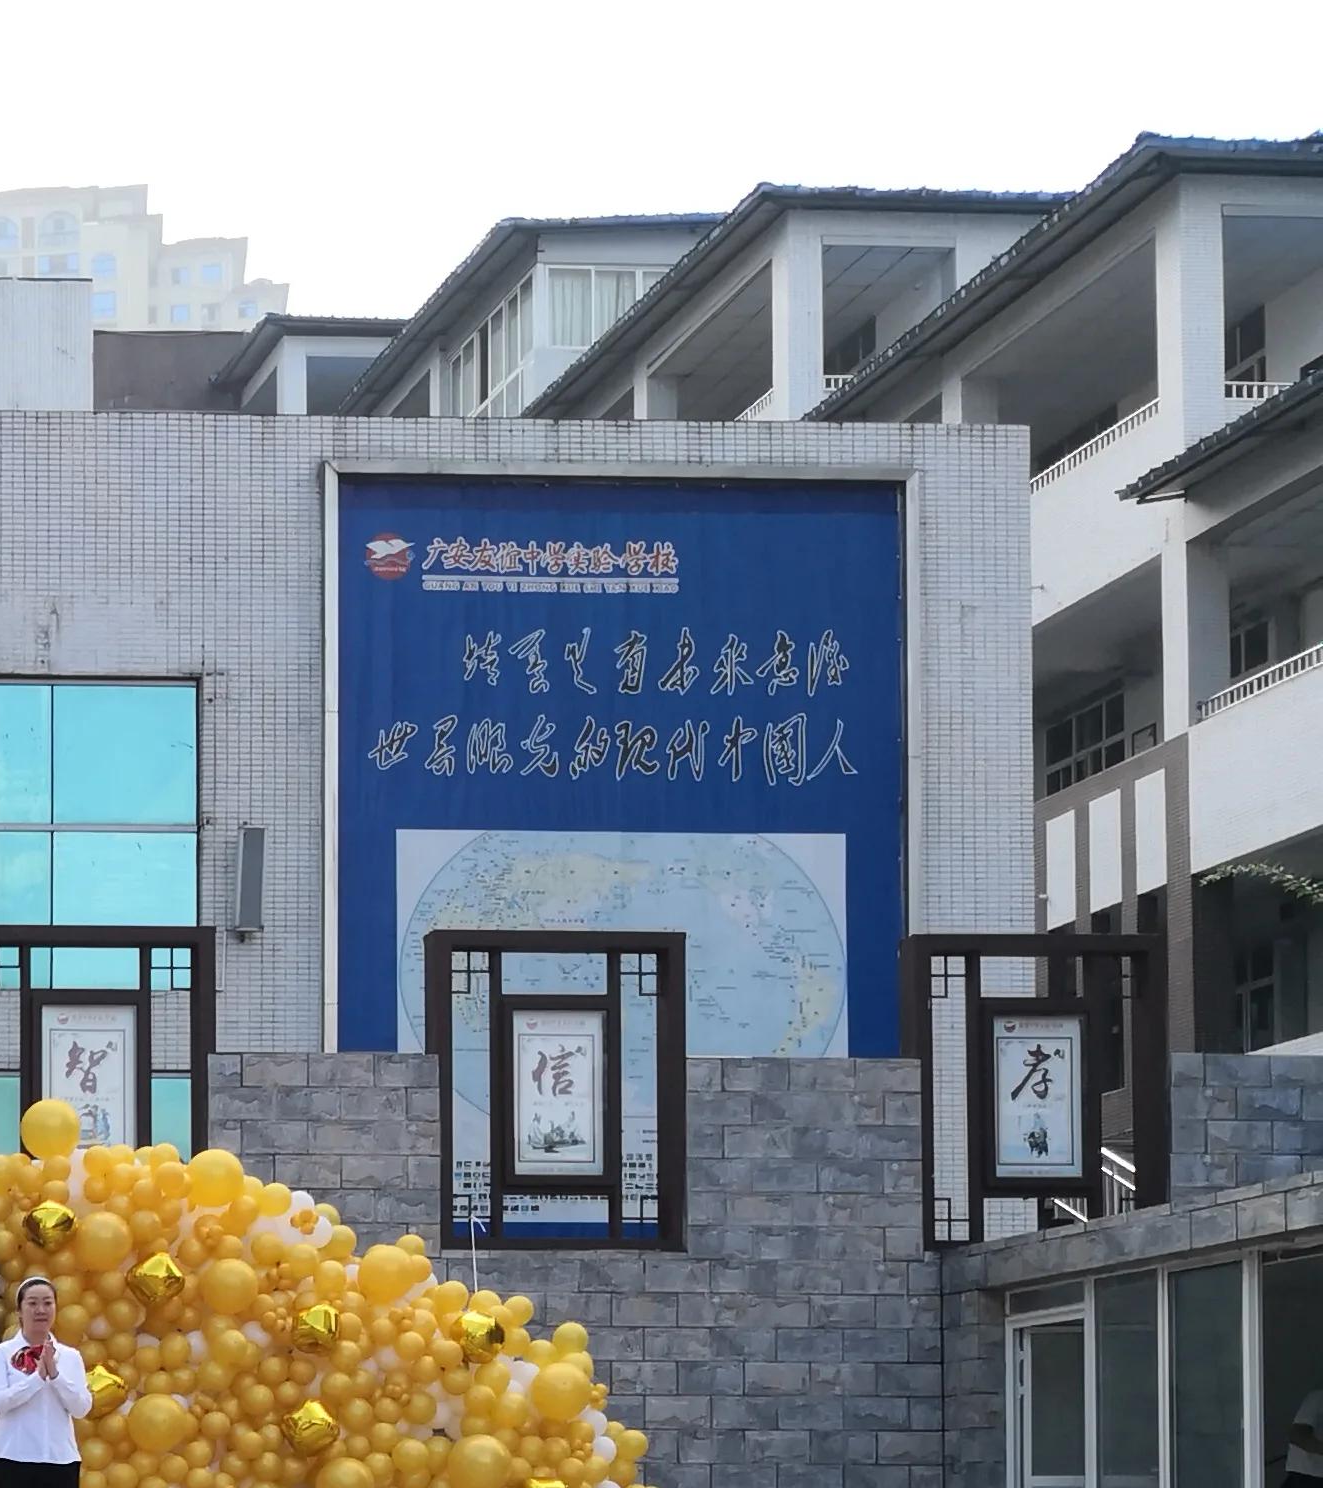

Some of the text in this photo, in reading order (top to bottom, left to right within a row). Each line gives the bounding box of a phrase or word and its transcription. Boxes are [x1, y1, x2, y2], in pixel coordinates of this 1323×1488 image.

[422, 537, 679, 575] 广安友谊中学实验学校
[65, 1040, 108, 1094] 智
[531, 1043, 575, 1097] 信
[1011, 1044, 1053, 1101] 孝
